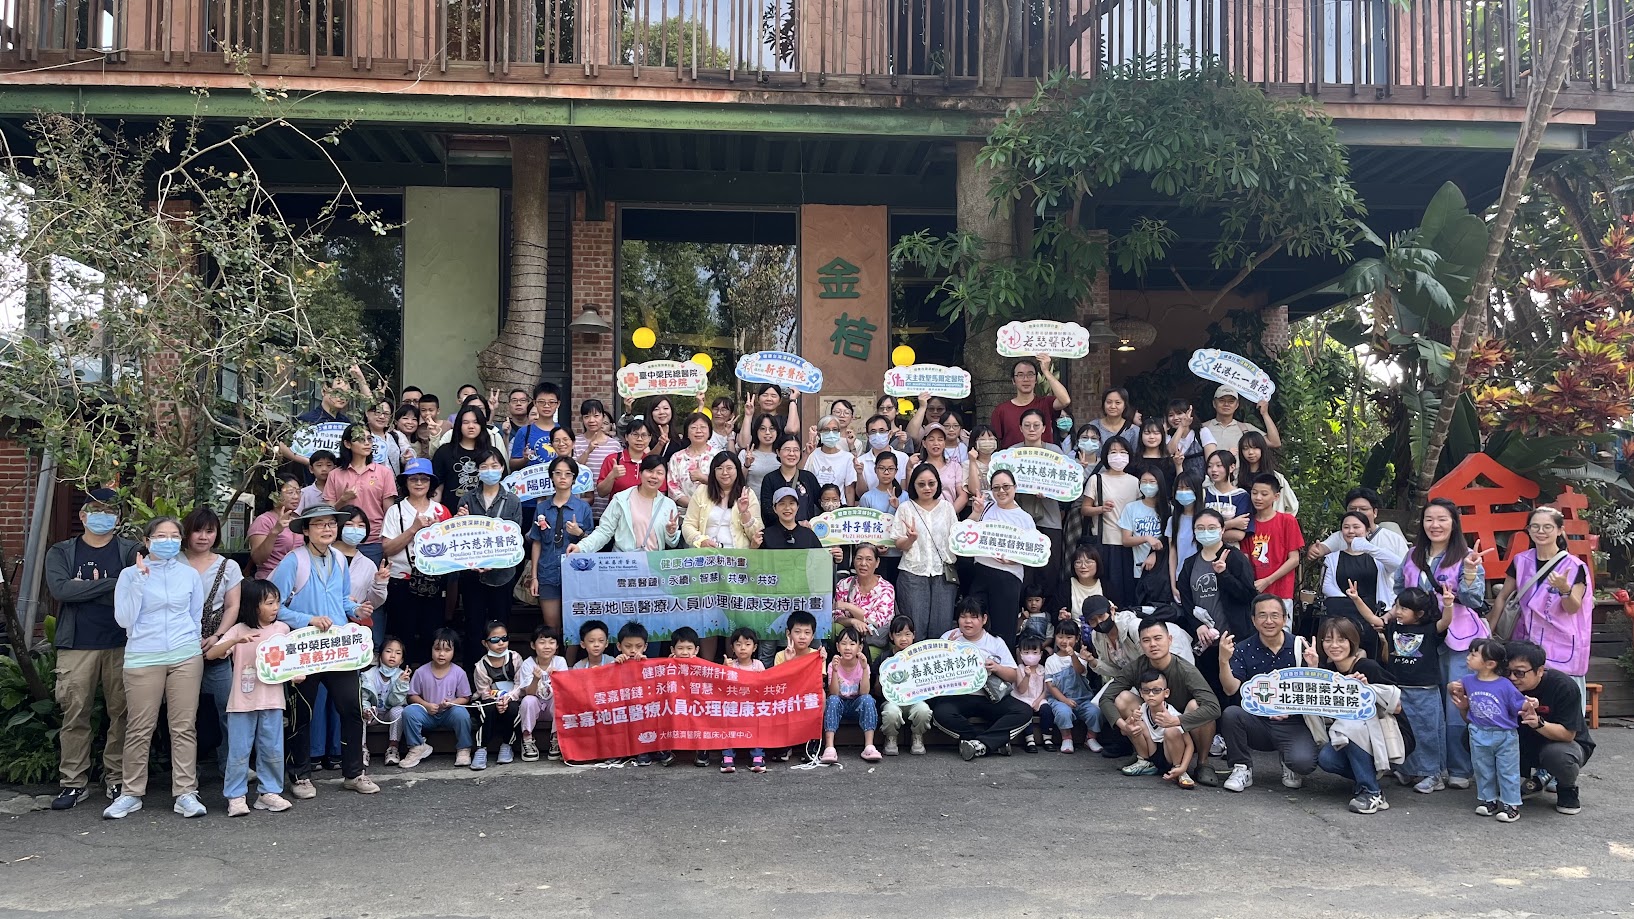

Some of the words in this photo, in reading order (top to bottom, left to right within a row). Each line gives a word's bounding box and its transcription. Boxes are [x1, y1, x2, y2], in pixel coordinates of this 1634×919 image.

[816, 256, 878, 361] 金桔
[639, 369, 698, 380] 臺中榮民總醫院
[765, 363, 807, 382] 新營醫院
[906, 374, 964, 383] 天主教聖馬爾定醫院
[1212, 362, 1269, 395] 北港仁一醫院
[649, 378, 688, 388] 灣橋分院
[1016, 463, 1079, 483] 大林慈濟醫院
[527, 477, 551, 492] 陽明
[444, 520, 491, 531] 健康台灣深耕計畫
[842, 520, 884, 533] 朴子醫院
[449, 534, 518, 552] 斗六慈濟醫院
[978, 536, 1045, 553] 嘉義基督教醫院
[661, 556, 747, 570] 健康台灣深耕計畫
[572, 594, 823, 616] 雲嘉地區醫療人員心理健康支持計畫
[286, 633, 363, 656] 臺中榮民總醫院
[907, 643, 949, 657] 健康台灣深耕計畫
[300, 647, 350, 665] 嘉義分院
[641, 663, 738, 681] 健康台灣深耕計畫
[911, 653, 979, 680] 嘉義慈濟診所
[1279, 681, 1359, 694] 中國醫藥大學
[1279, 693, 1359, 707] 北港附設醫院
[561, 692, 820, 730] 雲嘉地區醫療人員心理健康支持計畫
[660, 730, 702, 739] 大林慈濟醫院
[703, 731, 753, 739] 臨床心理中心
